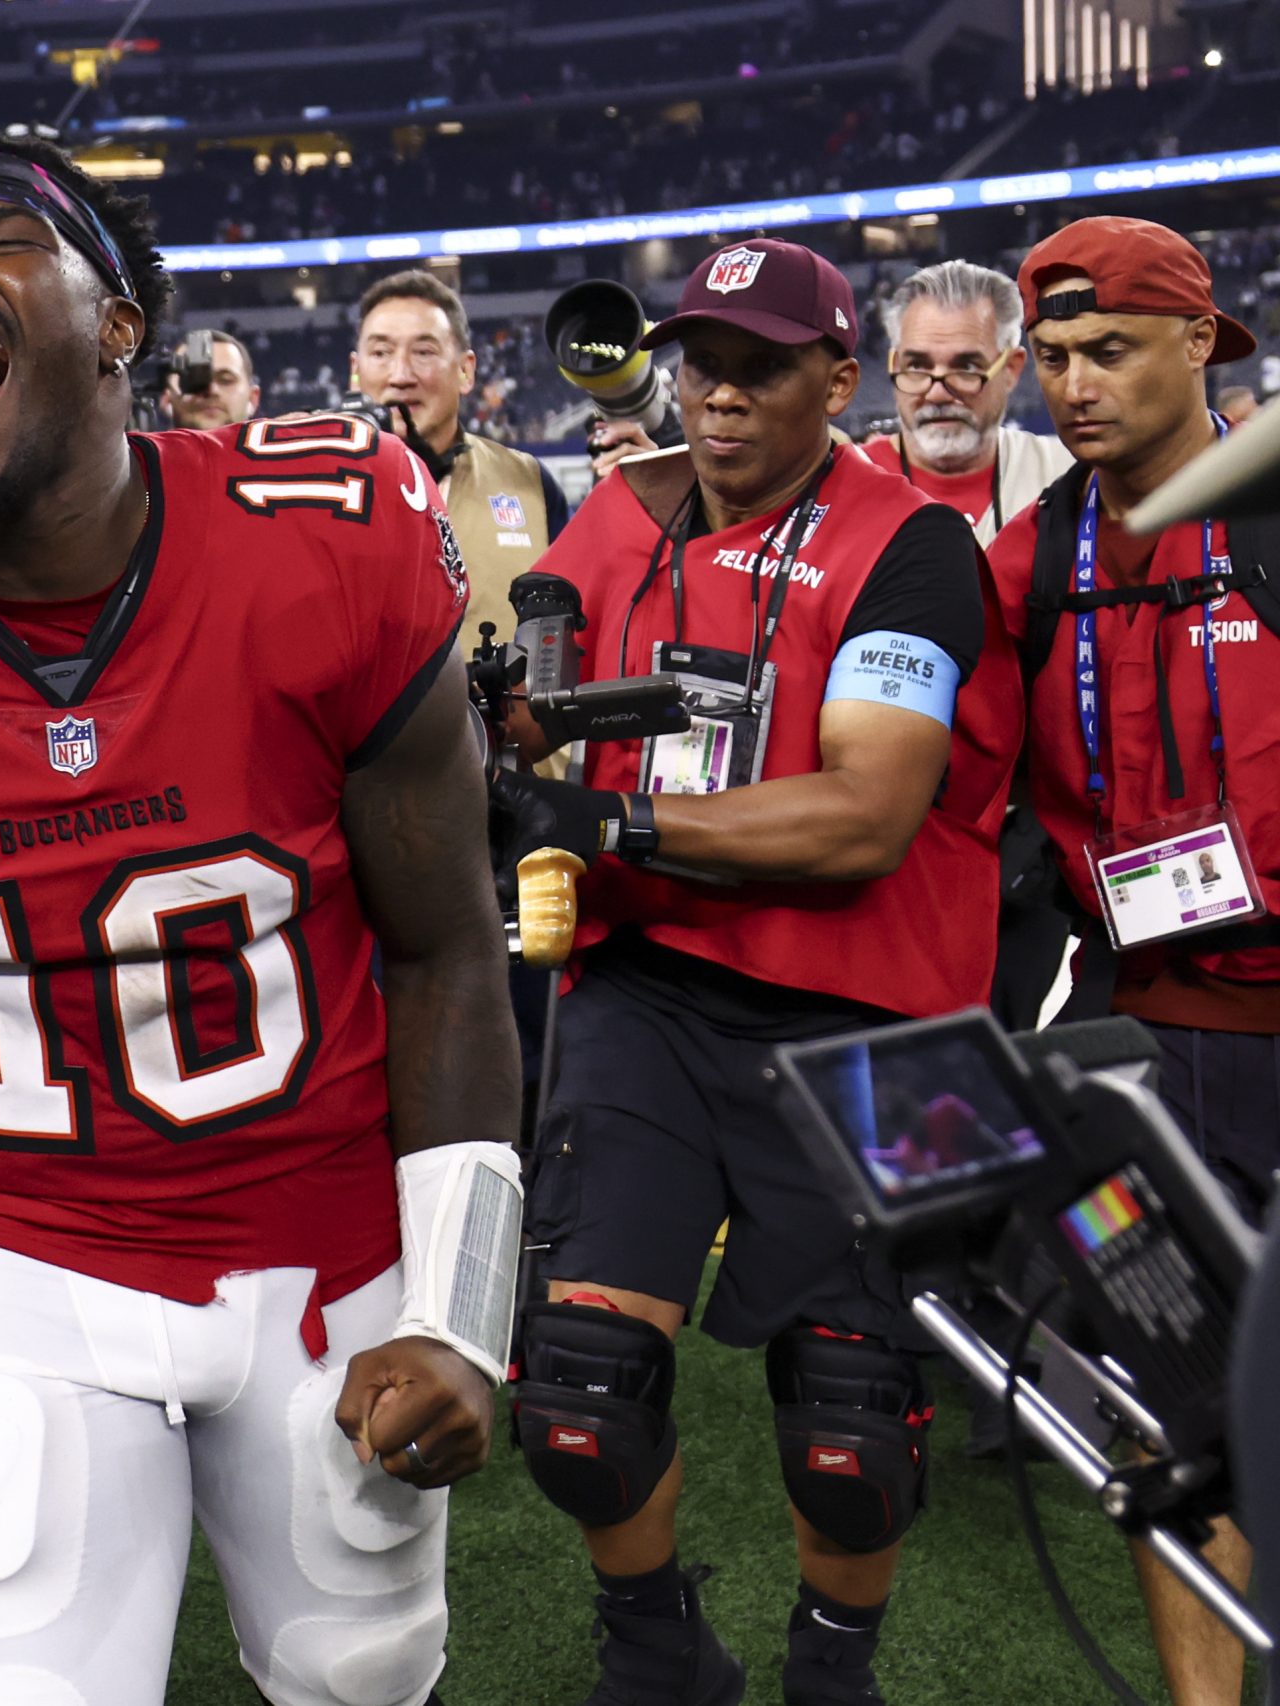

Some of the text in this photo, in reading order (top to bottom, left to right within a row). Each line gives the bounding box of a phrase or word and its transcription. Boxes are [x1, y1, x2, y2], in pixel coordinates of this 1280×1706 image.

[711, 263, 750, 287] NFL
[226, 412, 380, 526] 10
[889, 639, 911, 651] DAL
[591, 712, 641, 725] AMIRA
[55, 742, 90, 766] NFL
